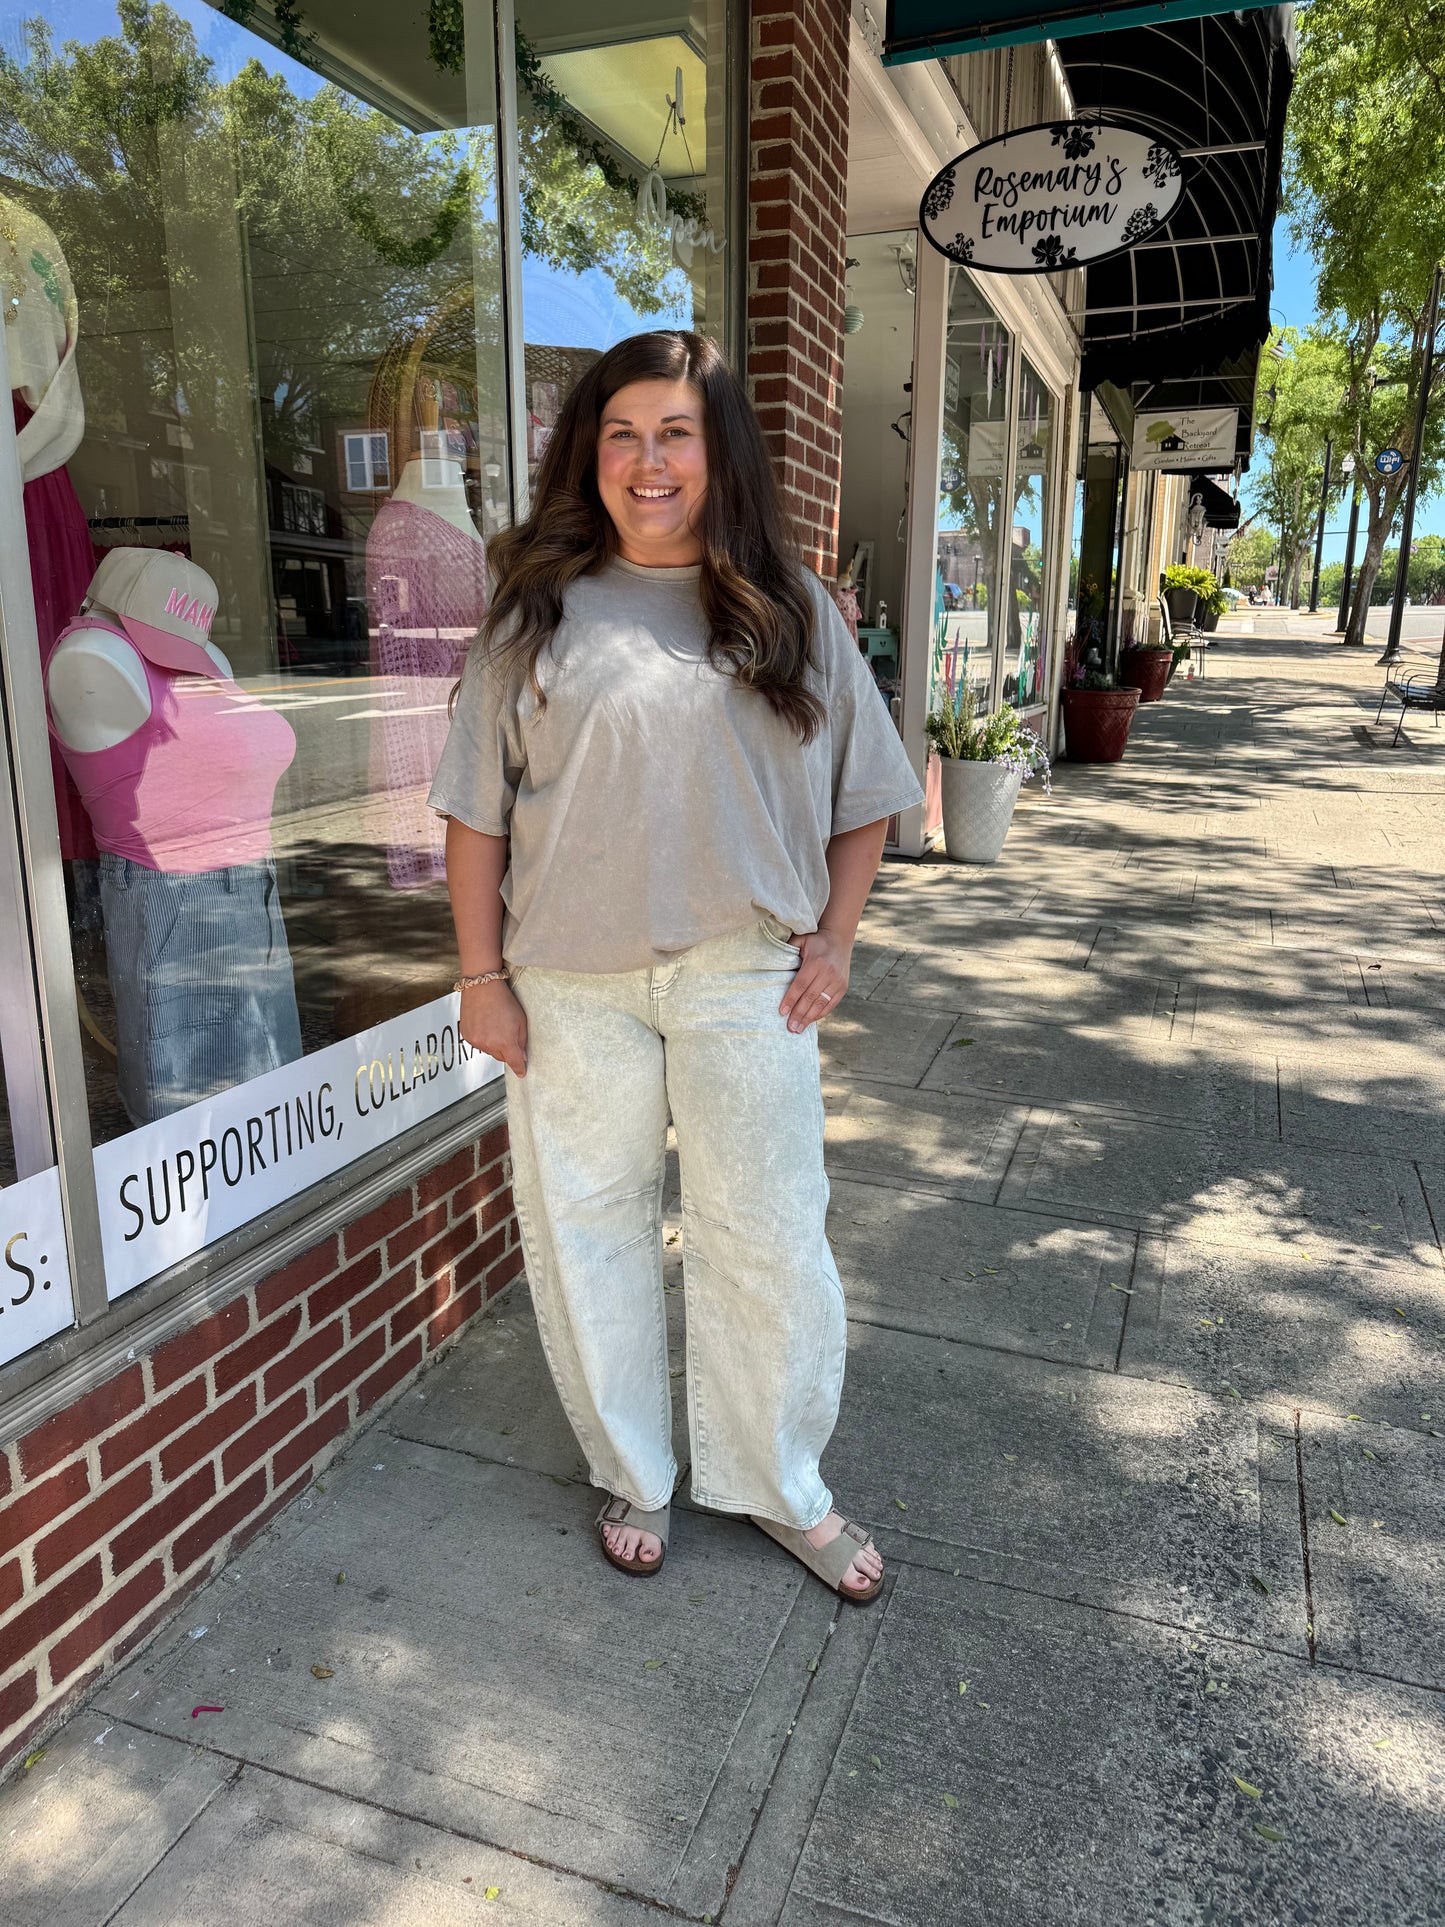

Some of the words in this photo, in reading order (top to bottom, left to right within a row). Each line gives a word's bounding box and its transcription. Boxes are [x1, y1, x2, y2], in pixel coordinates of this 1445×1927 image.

[974, 155, 1127, 208] Rosemary's
[981, 202, 1118, 244] Emporium
[1179, 416, 1195, 426] The
[1181, 427, 1217, 439] Backyard
[1183, 442, 1210, 450] Retreat
[164, 587, 216, 634] MAM
[119, 1082, 344, 1242] SUPPORTING,
[354, 1020, 482, 1117] COLLABOR
[0, 1232, 51, 1315] S:
